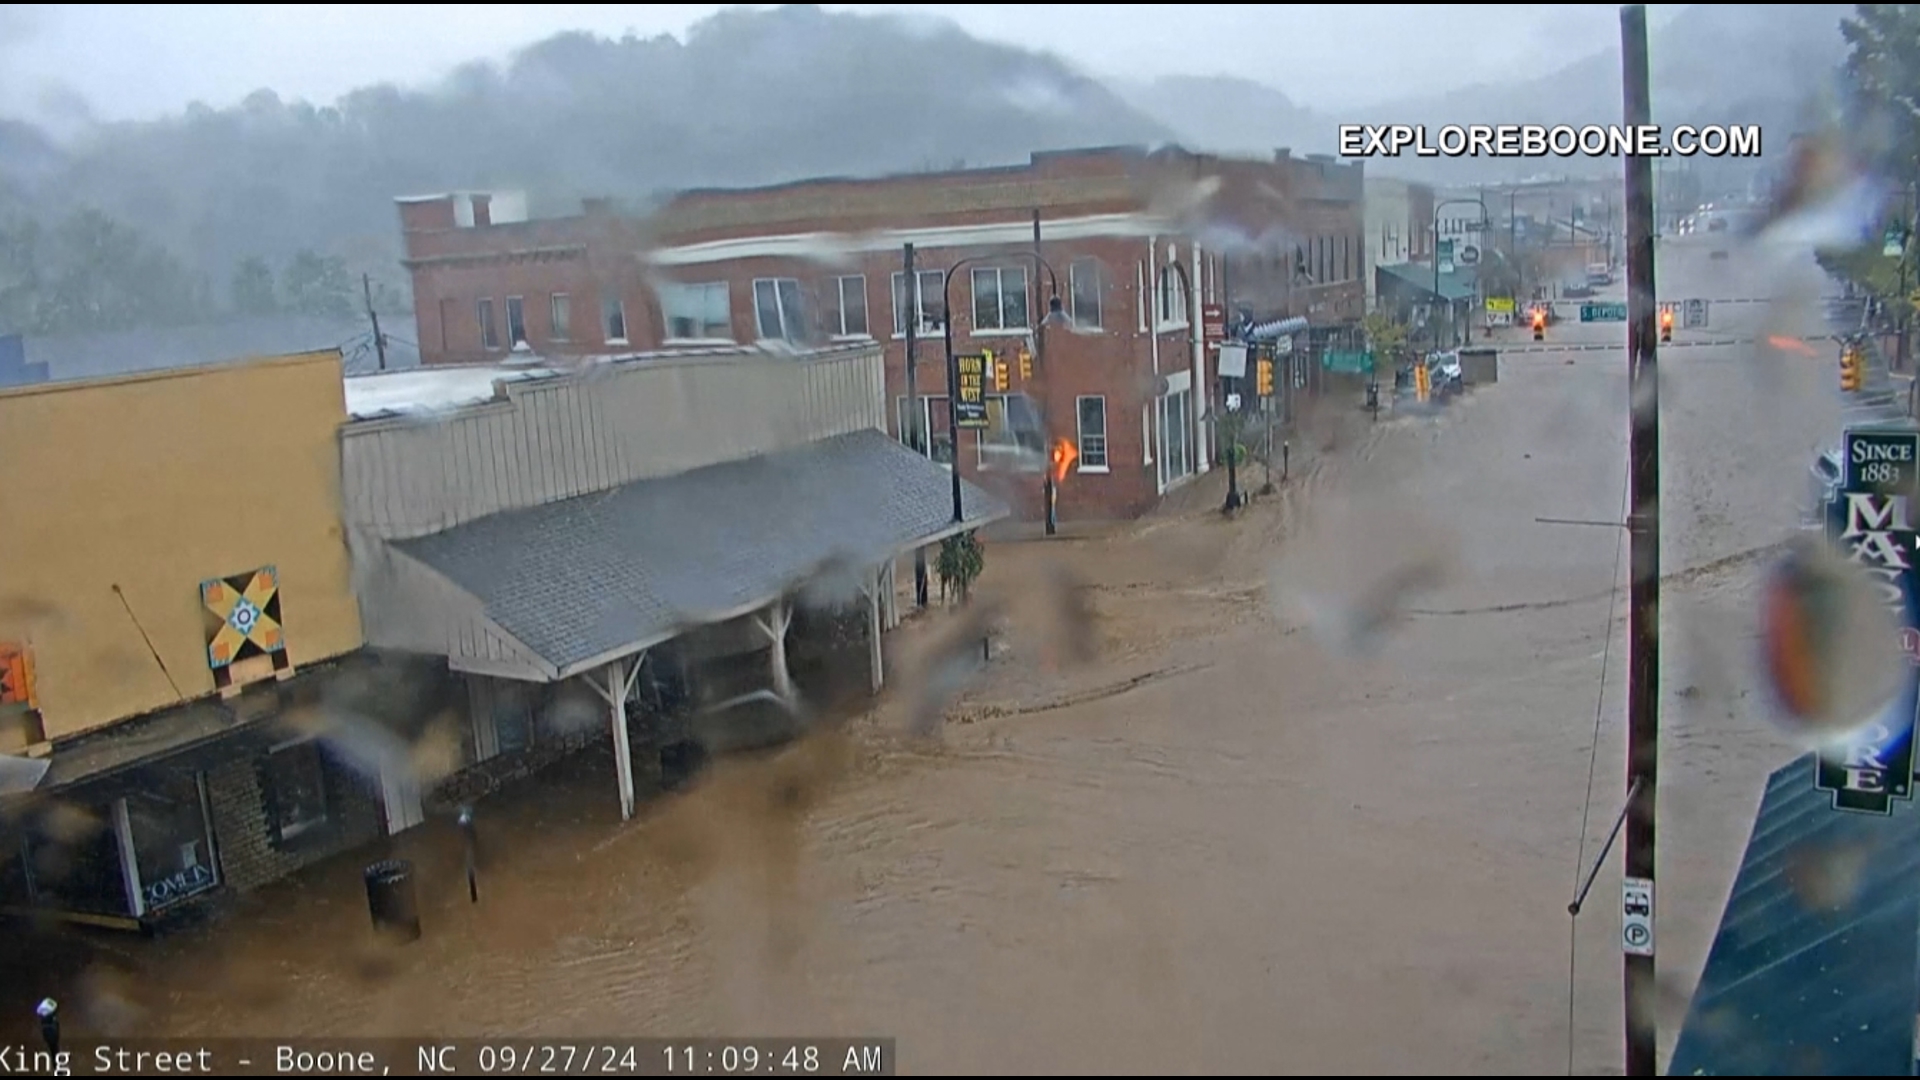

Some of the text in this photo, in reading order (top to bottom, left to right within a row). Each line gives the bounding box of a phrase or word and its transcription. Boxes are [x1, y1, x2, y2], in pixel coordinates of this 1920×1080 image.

[958, 357, 982, 374] HORN
[960, 387, 981, 403] WEST
[1861, 463, 1899, 485] 1883
